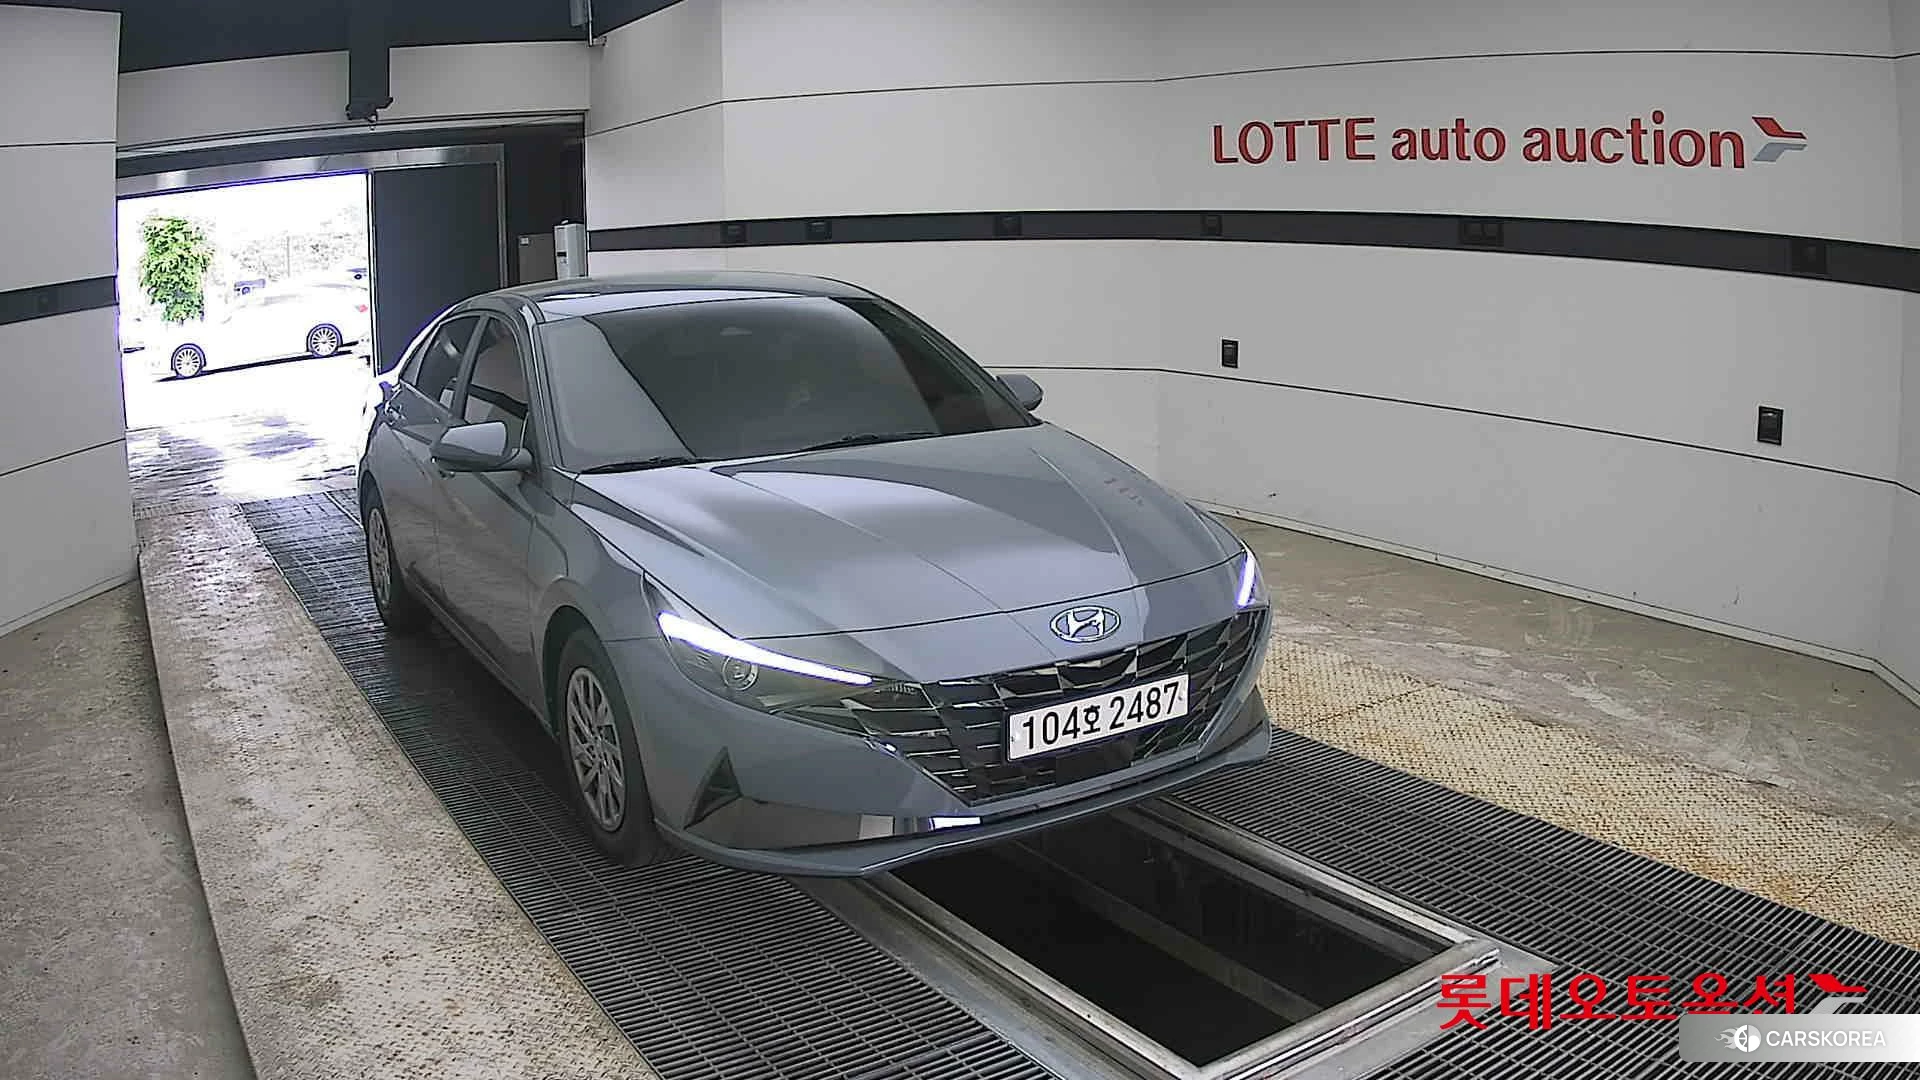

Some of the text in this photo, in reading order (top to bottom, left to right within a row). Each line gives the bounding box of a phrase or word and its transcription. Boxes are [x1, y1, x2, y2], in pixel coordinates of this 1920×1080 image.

[1212, 110, 1746, 169] LOTTE auto auction
[1109, 681, 1180, 731] 2487
